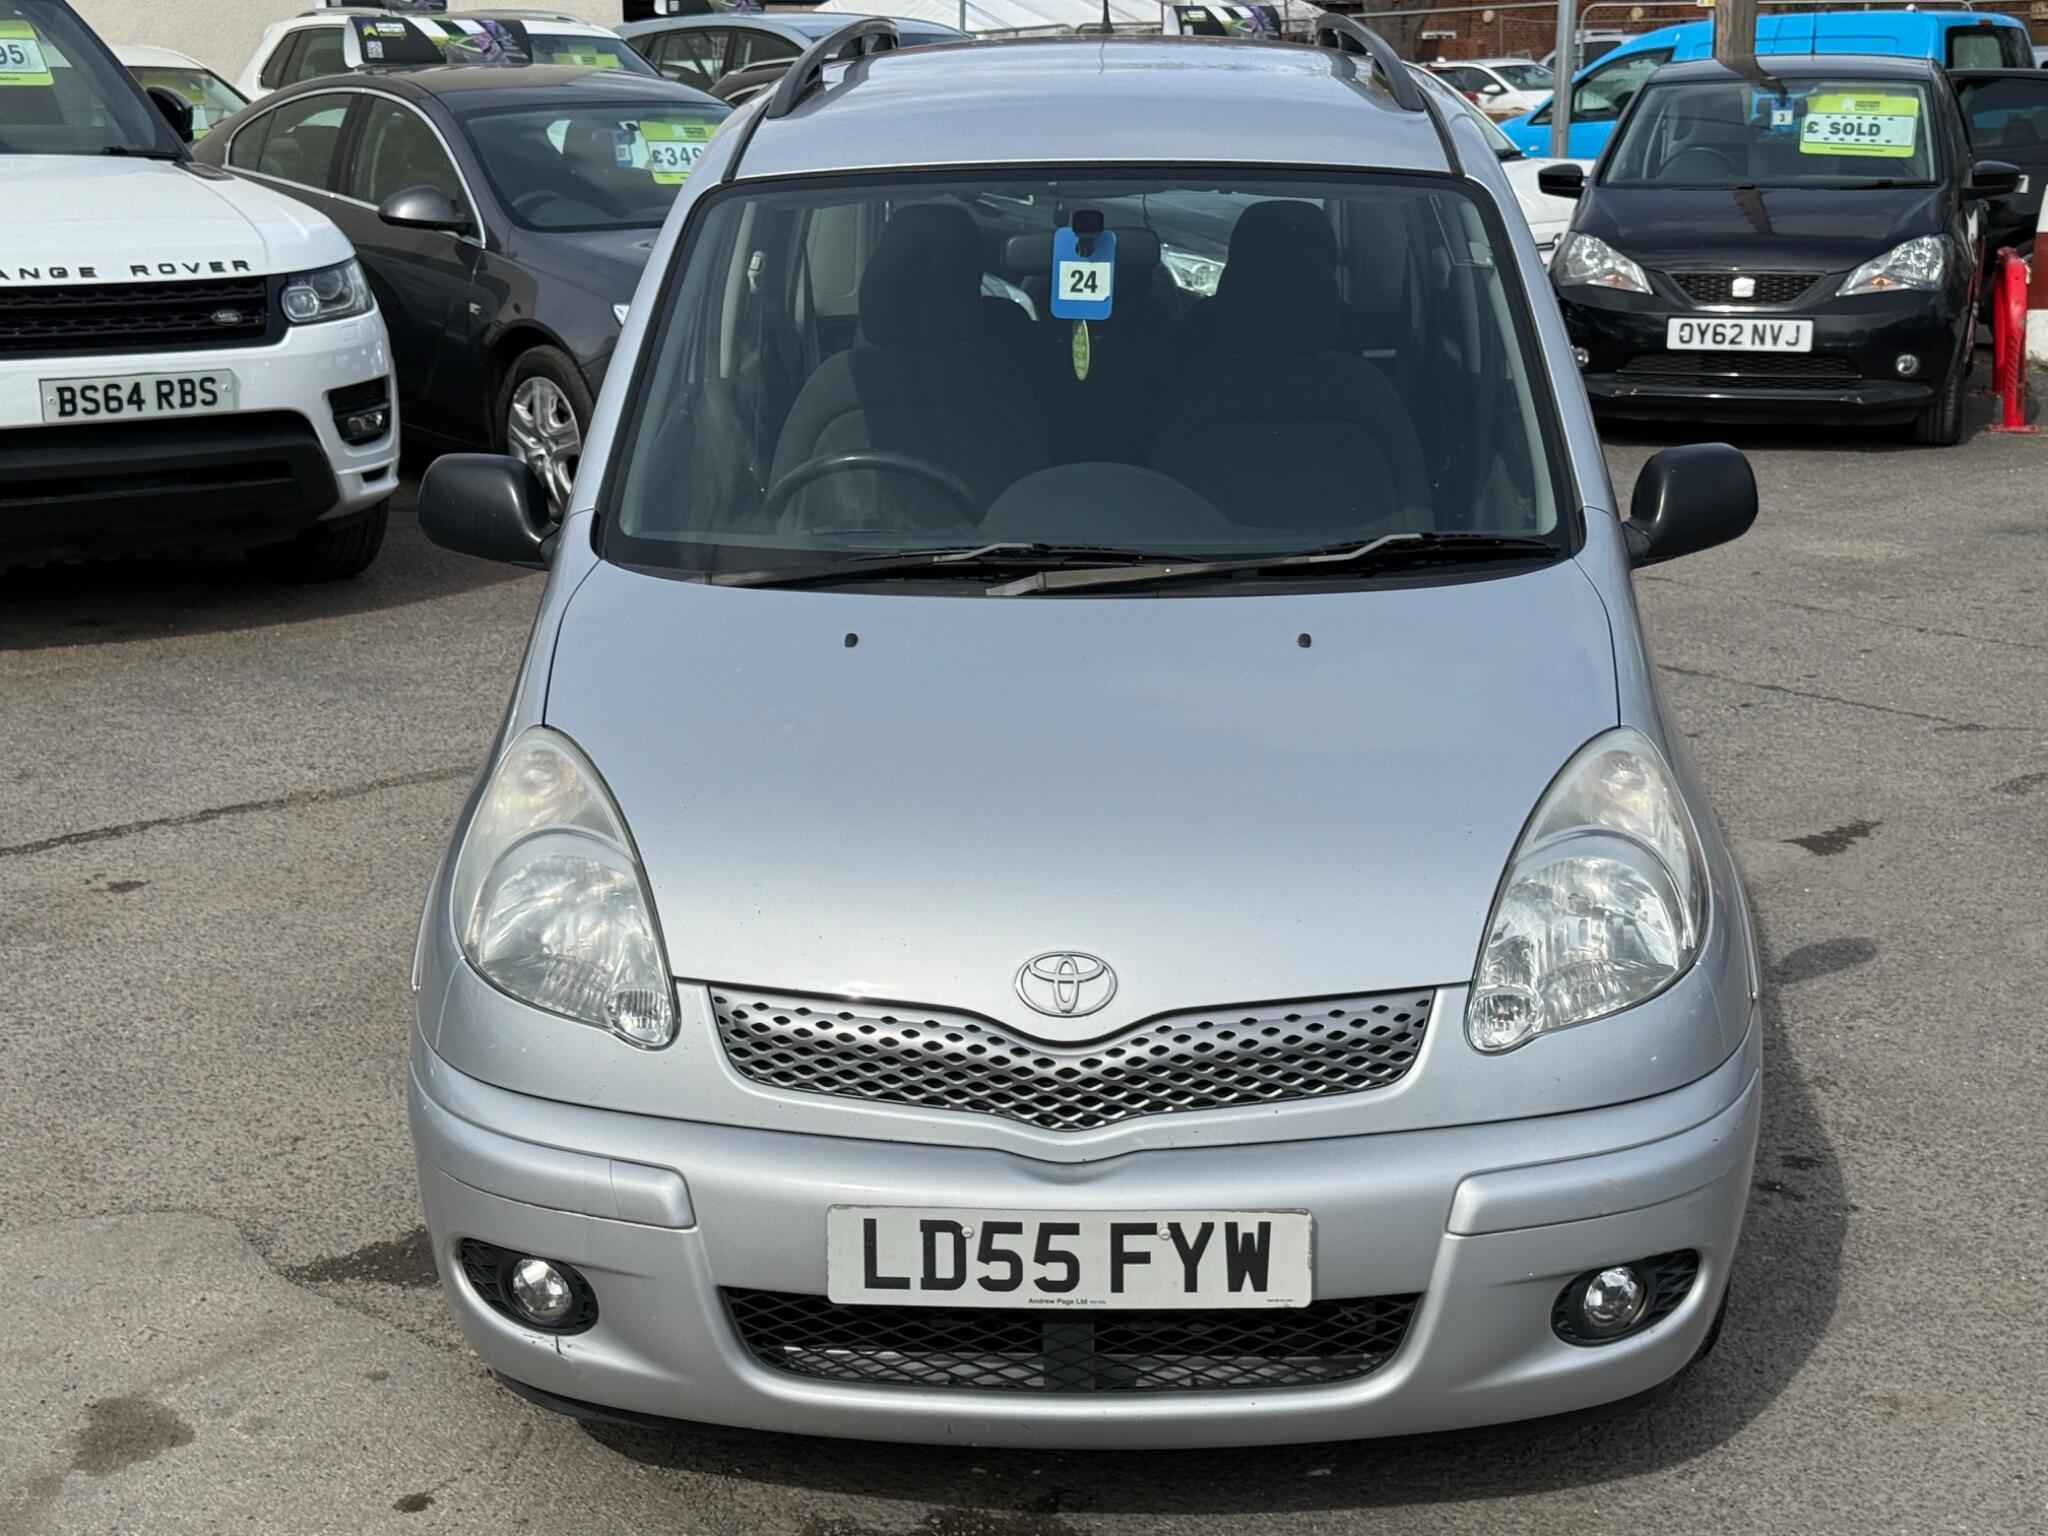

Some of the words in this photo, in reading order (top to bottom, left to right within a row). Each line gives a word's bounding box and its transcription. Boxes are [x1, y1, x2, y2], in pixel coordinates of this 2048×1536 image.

[1806, 121, 1819, 133] £
[1829, 121, 1881, 136] SOLD
[130, 260, 251, 277] ROVER
[1070, 269, 1098, 293] 24
[1679, 323, 1743, 345] OY62
[1751, 324, 1801, 347] NVJ
[56, 382, 146, 417] BS64
[155, 377, 218, 410] RBS
[863, 1218, 1081, 1293] LD55
[1110, 1221, 1271, 1293] FYW
[1057, 1297, 1074, 1306] Page
